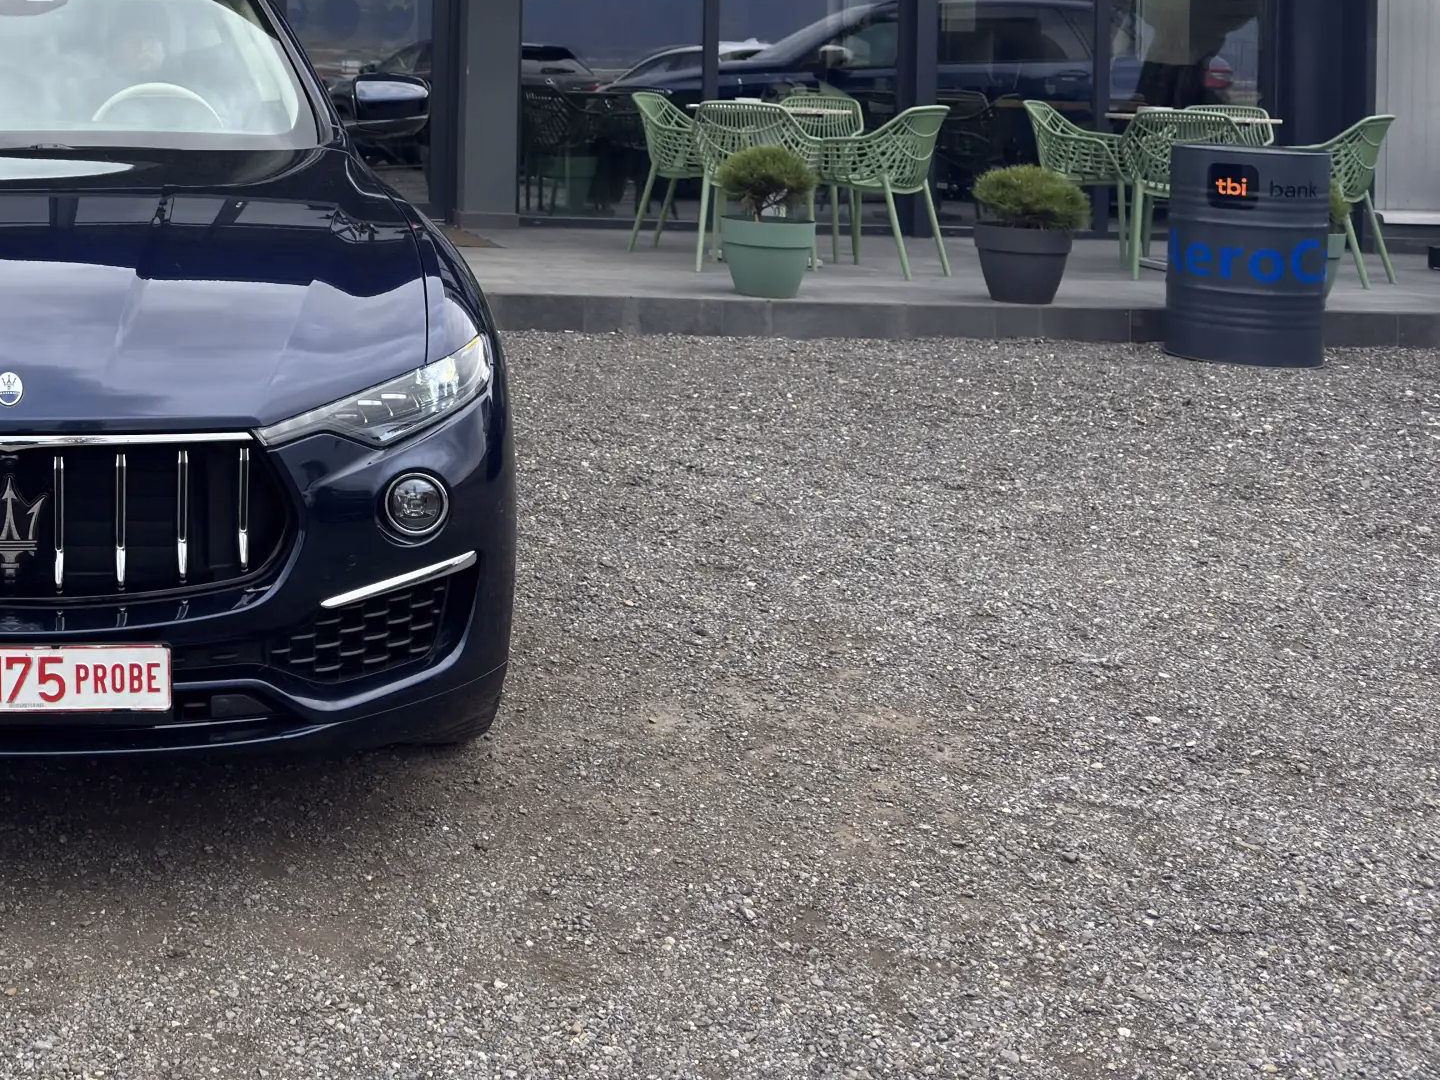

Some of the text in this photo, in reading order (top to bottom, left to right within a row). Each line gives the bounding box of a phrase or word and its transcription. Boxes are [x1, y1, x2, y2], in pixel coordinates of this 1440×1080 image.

[1215, 177, 1318, 199] tbi bank
[1168, 228, 1328, 284] AeroC
[75, 662, 161, 694] PROBE
